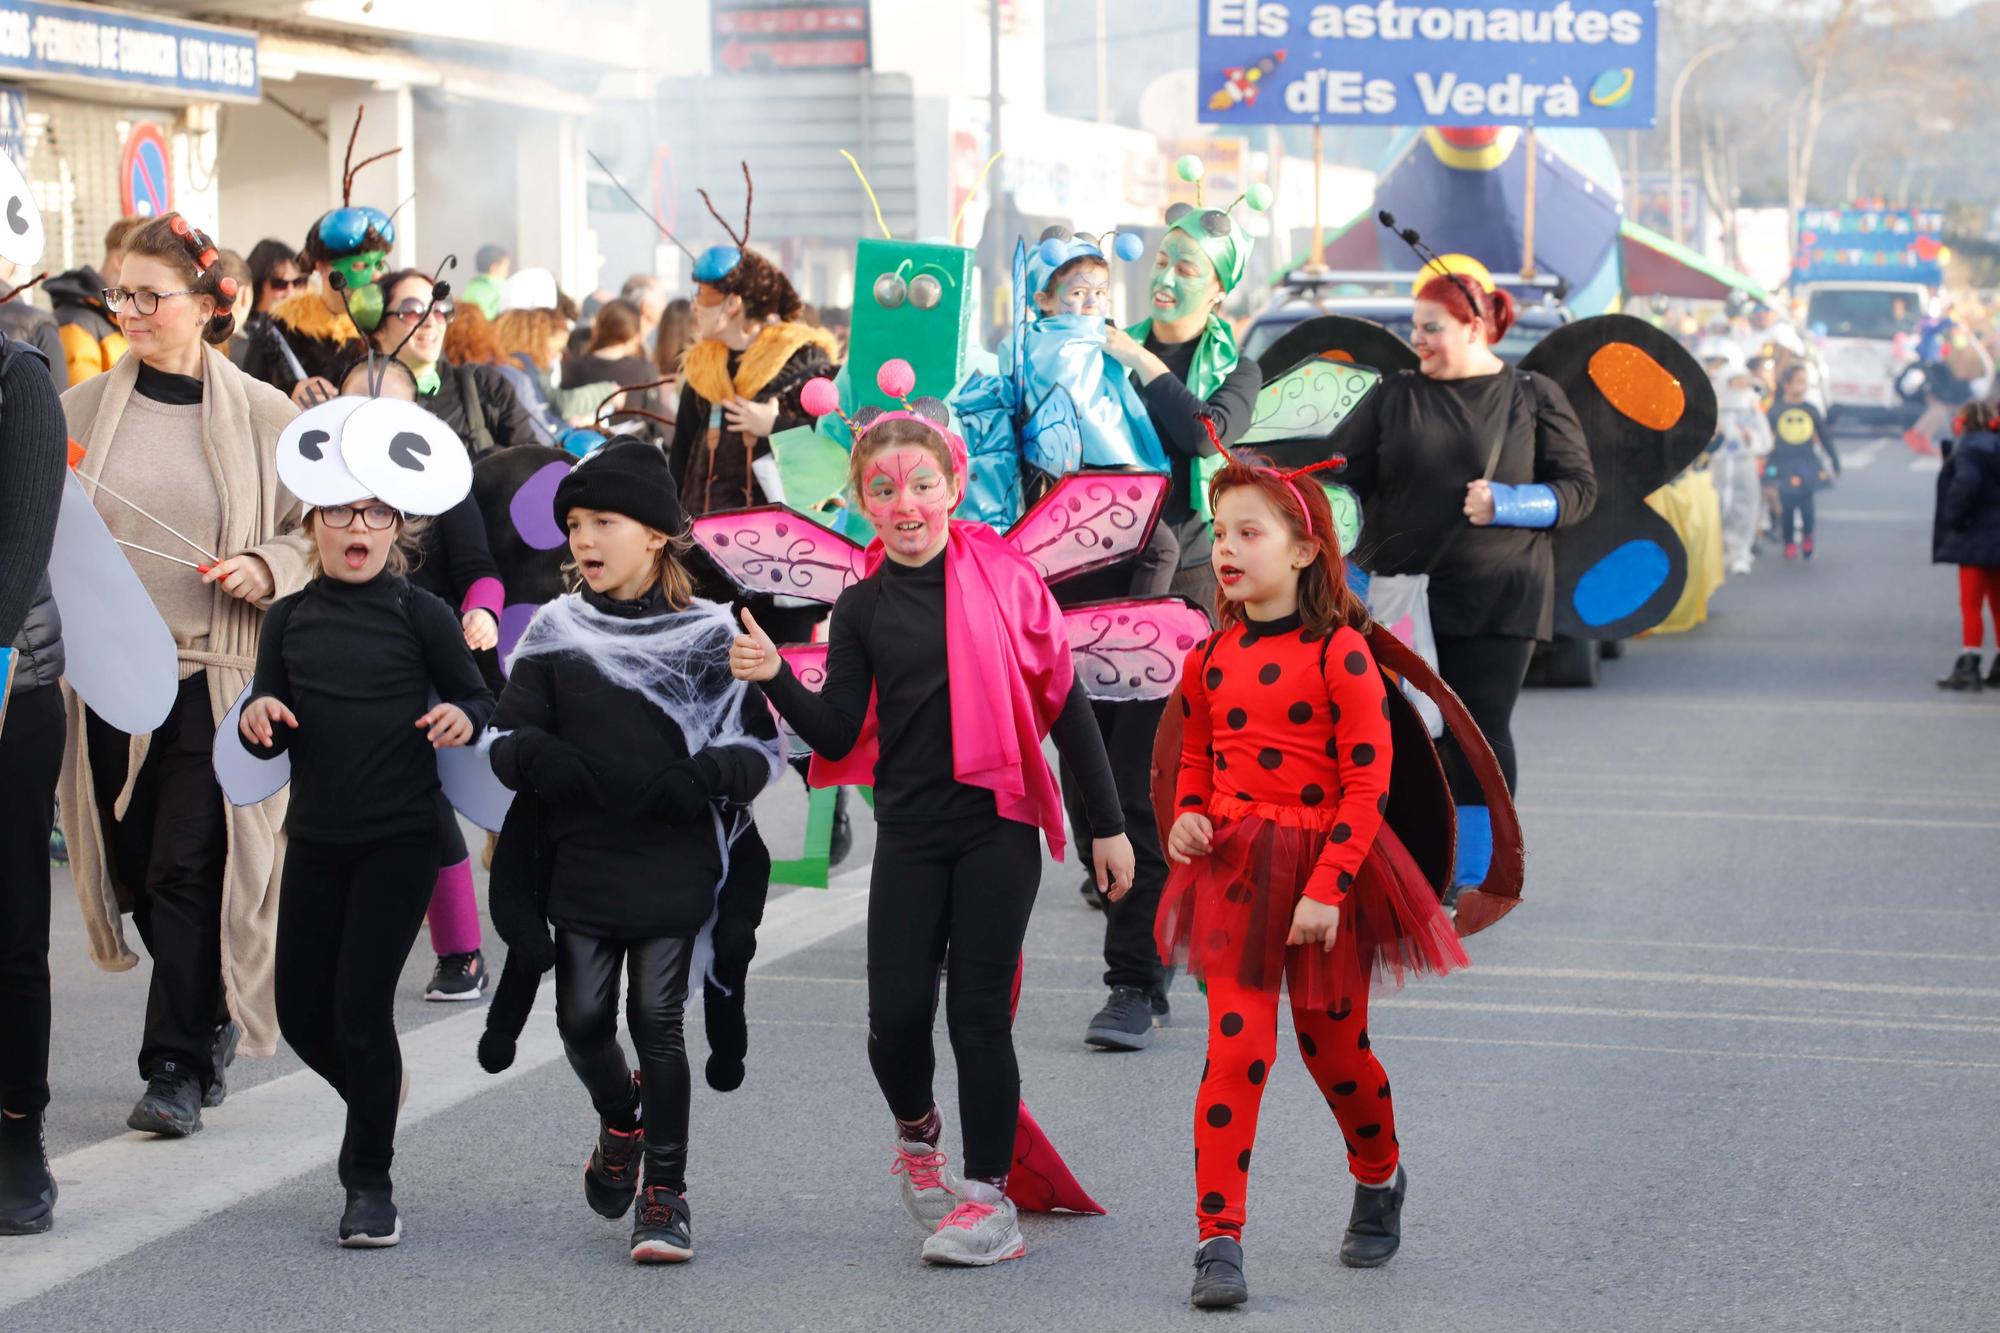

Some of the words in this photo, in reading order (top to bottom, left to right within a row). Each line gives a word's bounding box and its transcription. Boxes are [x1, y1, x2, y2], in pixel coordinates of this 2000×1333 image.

[1206, 0, 1289, 37] Els
[1308, 0, 1643, 44] astronautes
[1285, 68, 1397, 114] d'Es
[1413, 72, 1580, 118] Vedrà
